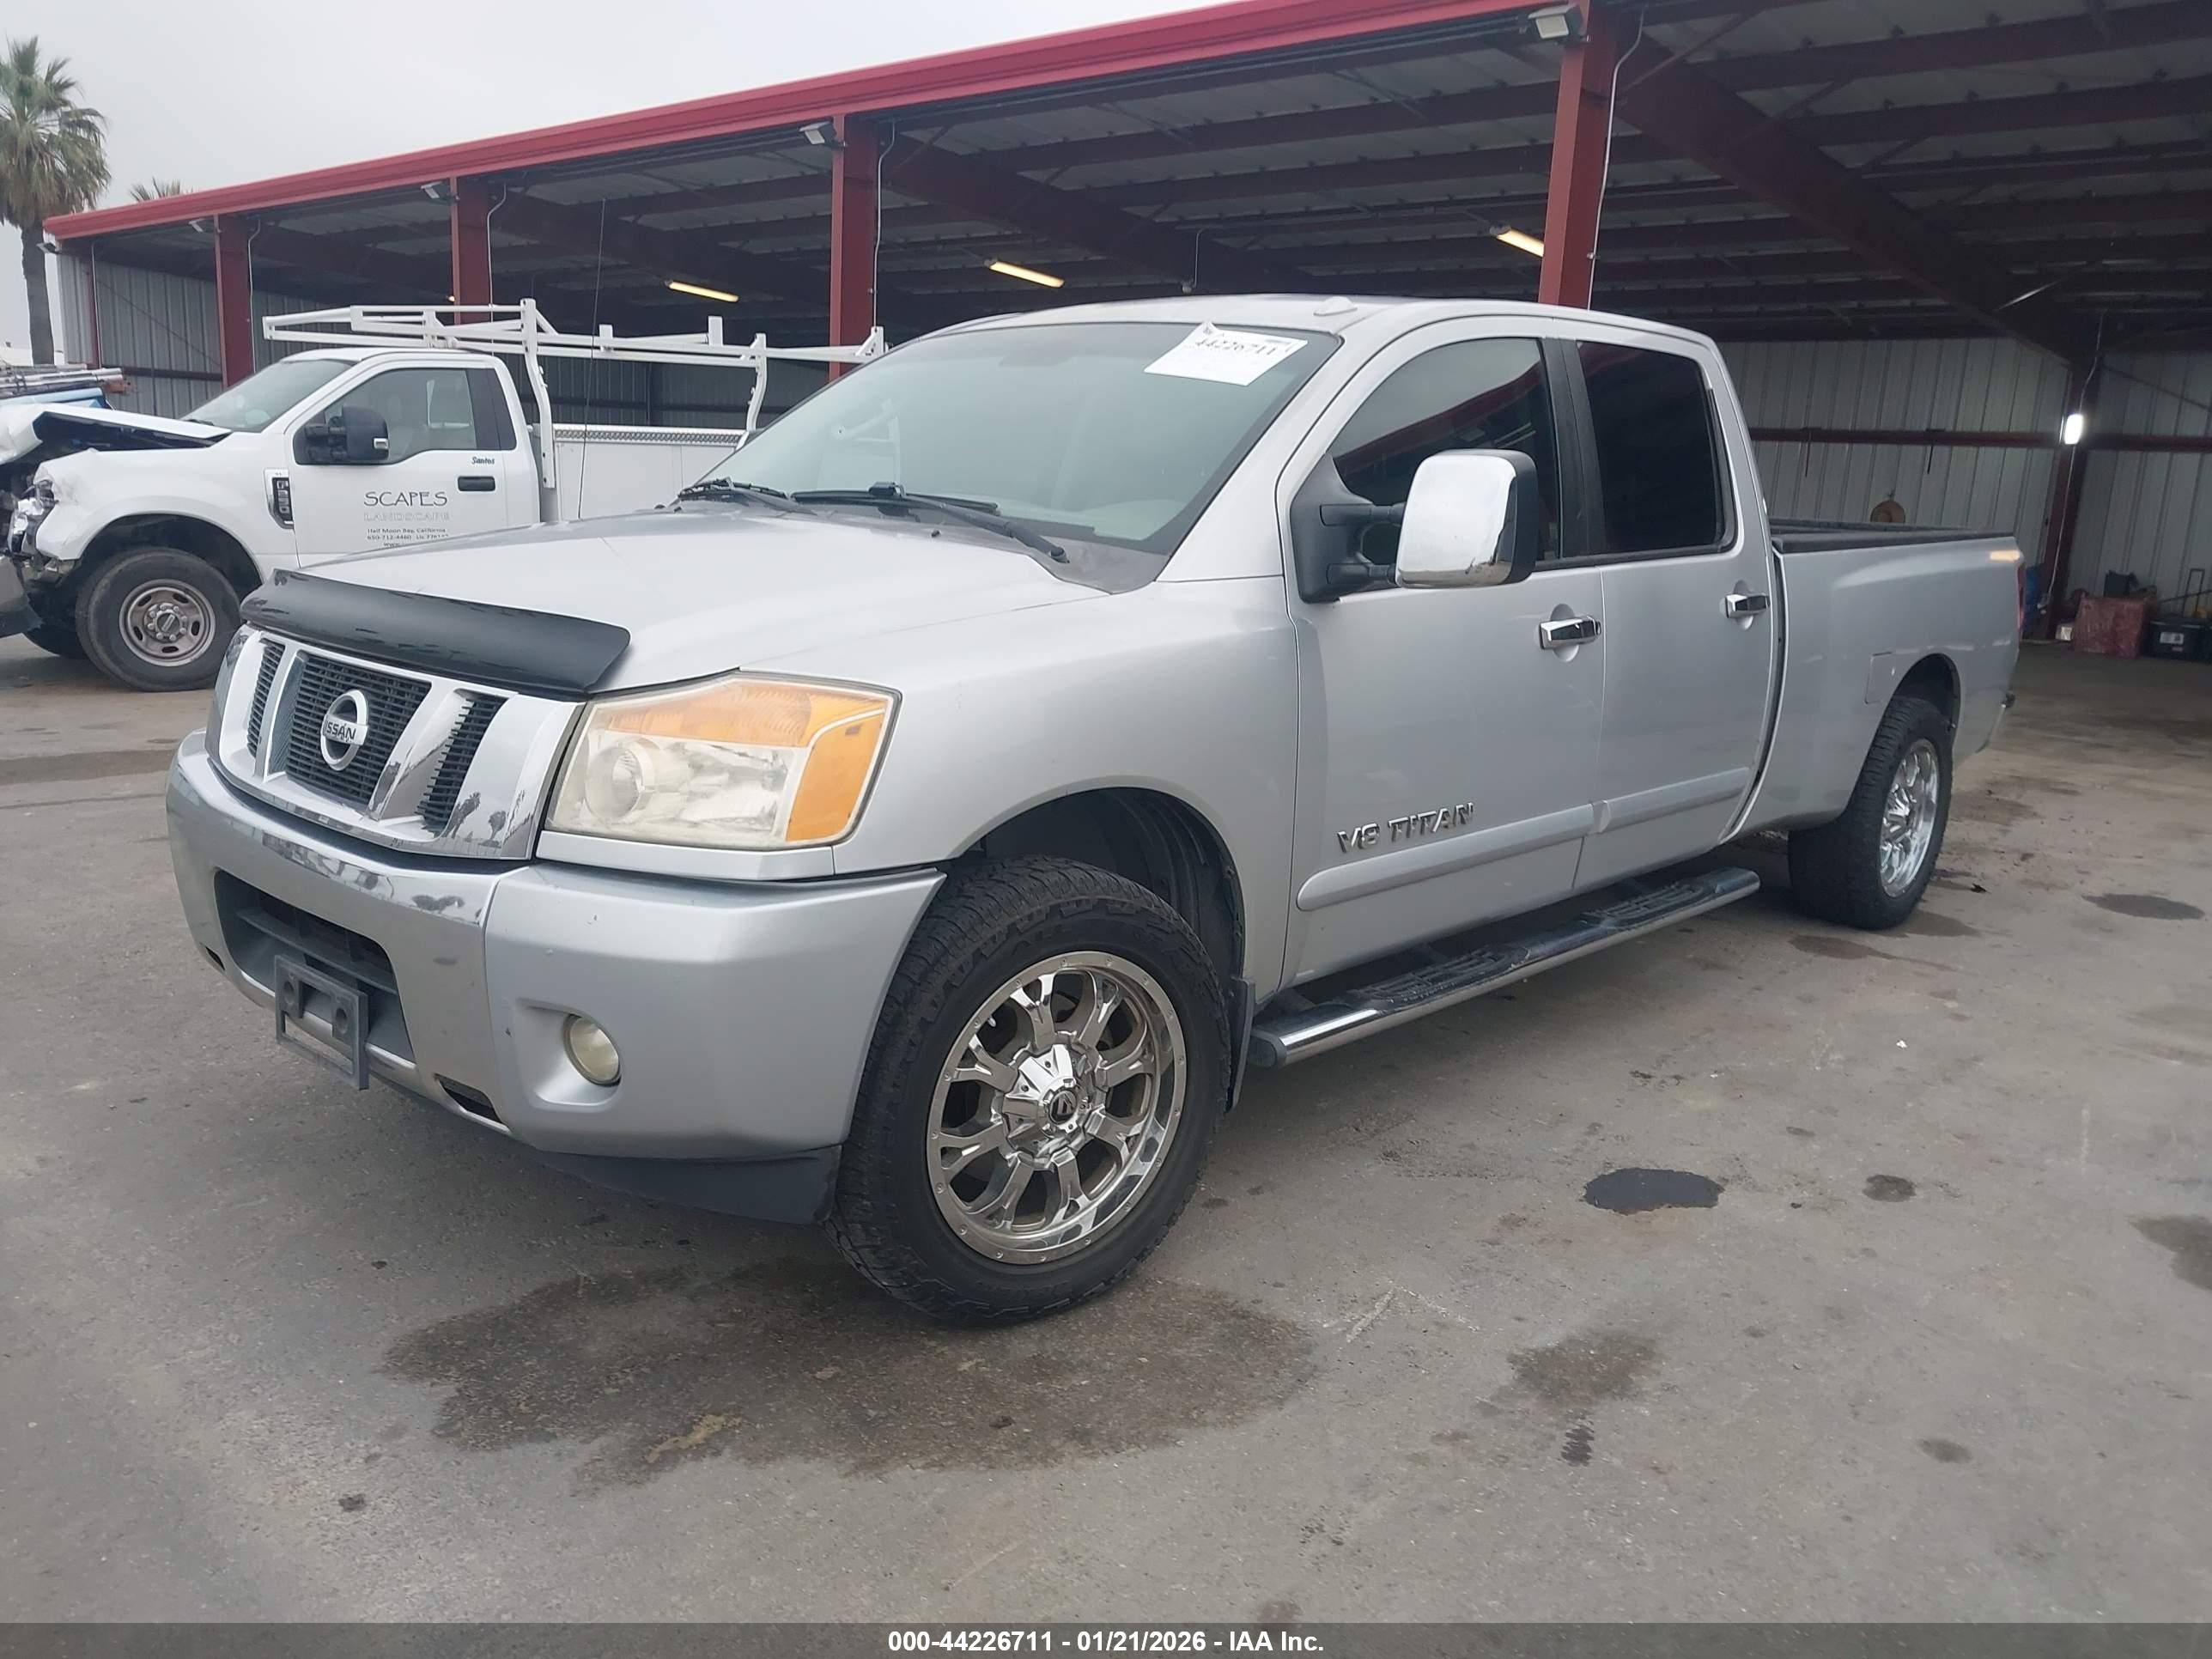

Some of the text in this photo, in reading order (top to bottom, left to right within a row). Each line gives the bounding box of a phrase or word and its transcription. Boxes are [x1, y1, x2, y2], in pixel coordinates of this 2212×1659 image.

[471, 456, 495, 465] Santos
[363, 490, 448, 507] SCAPES
[1337, 802, 1474, 854] V8 TITAN
